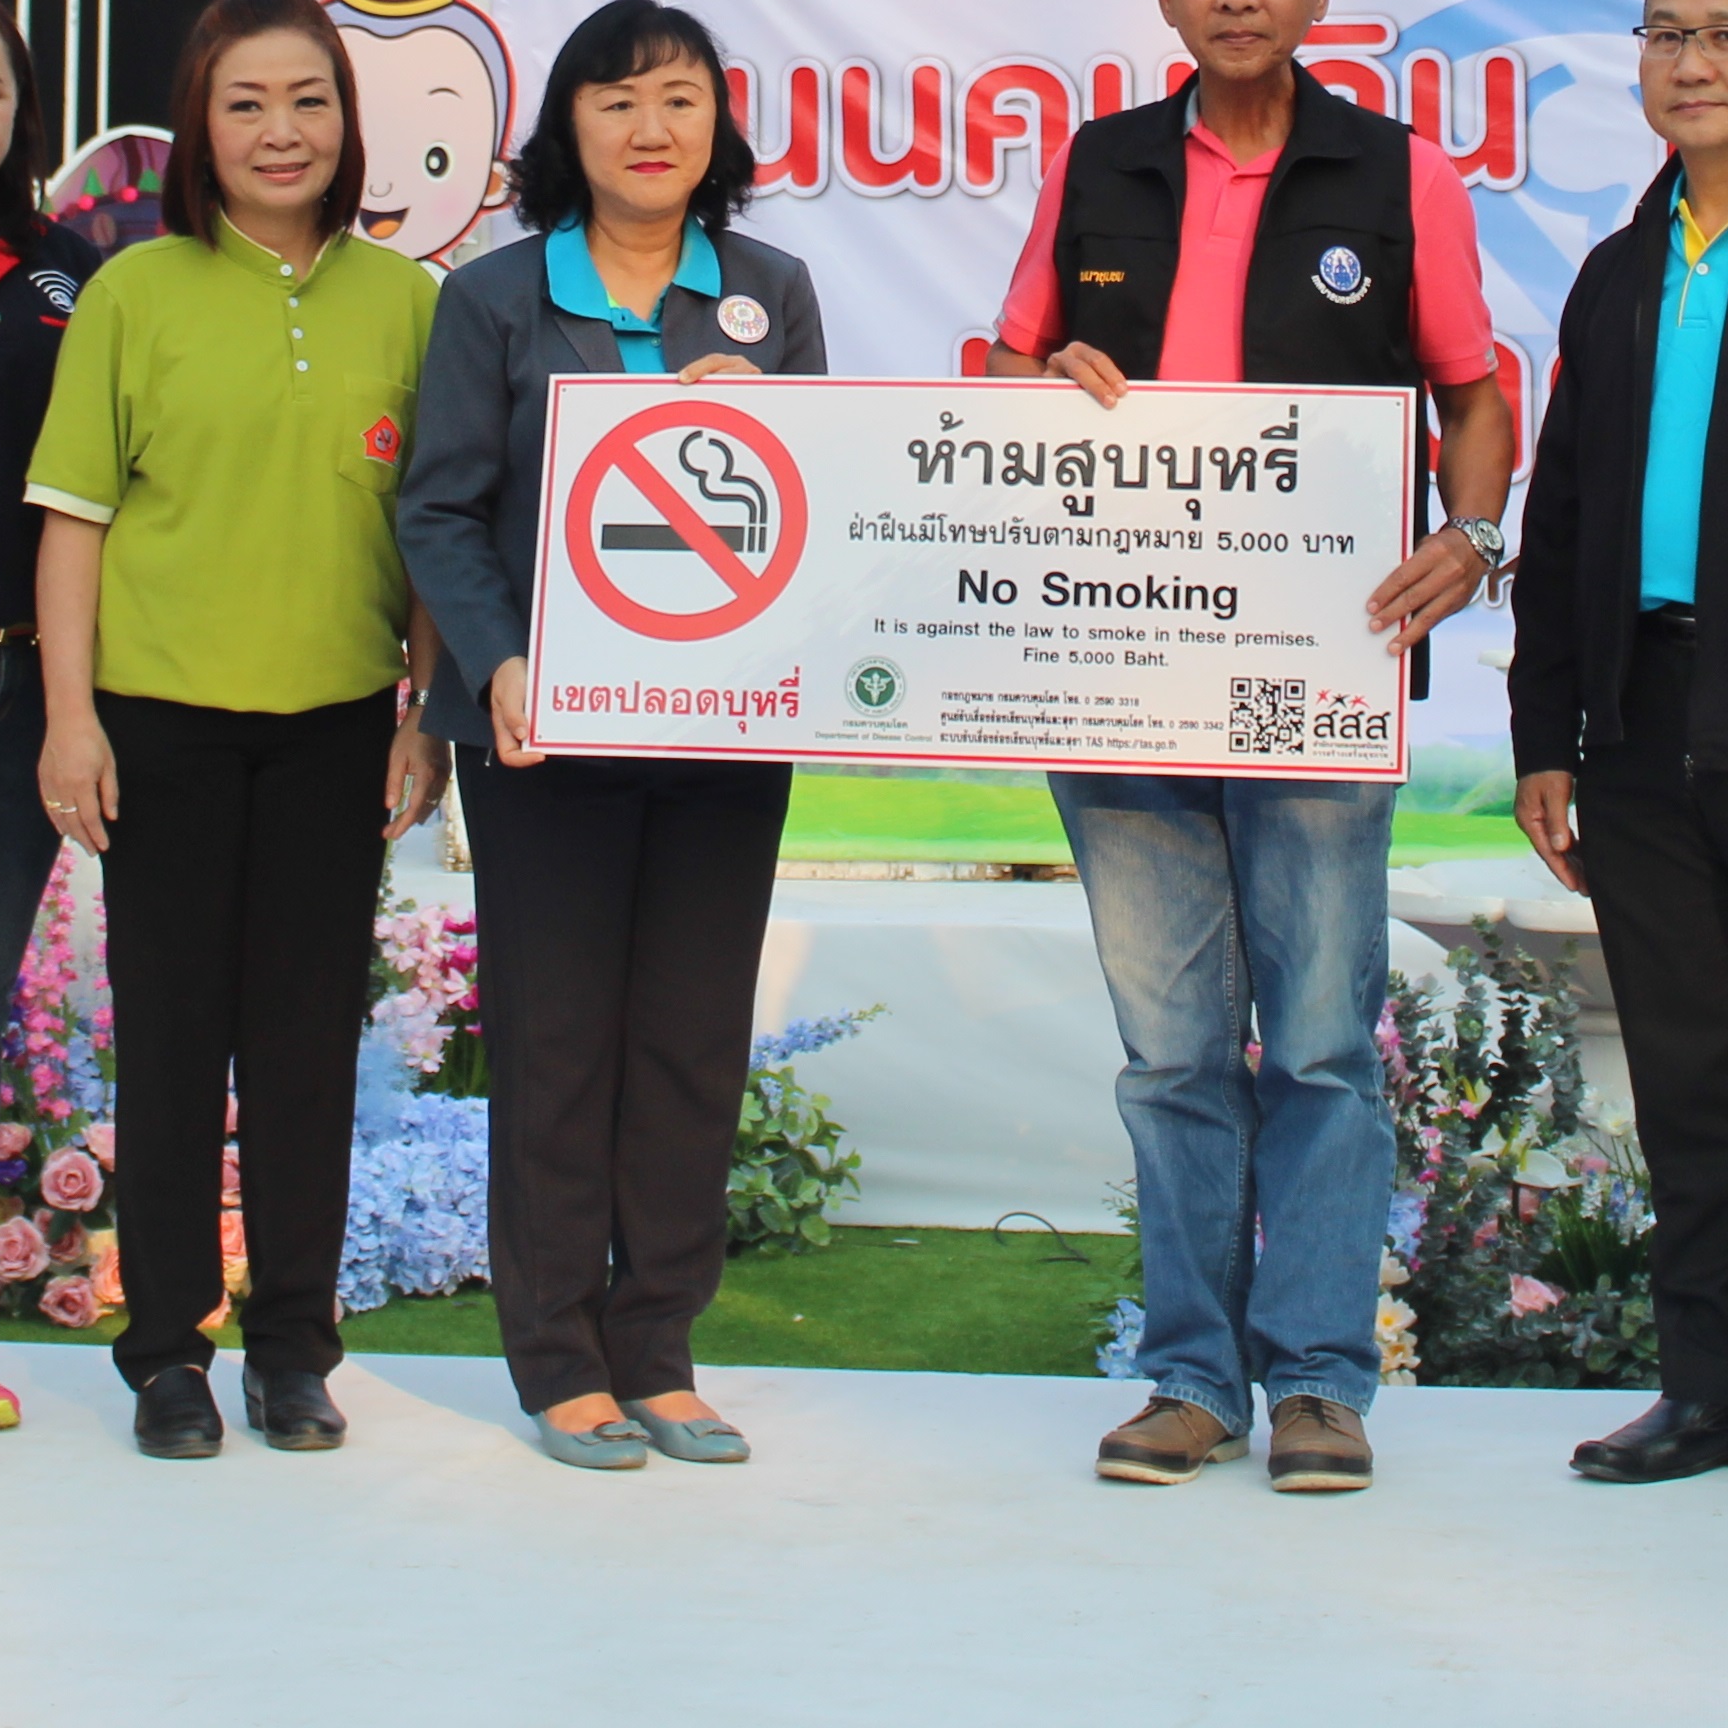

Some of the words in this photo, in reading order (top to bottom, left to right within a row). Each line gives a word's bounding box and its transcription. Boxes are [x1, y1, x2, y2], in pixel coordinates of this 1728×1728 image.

[906, 405, 1300, 522] ห้ามสูบบุหรี่
[848, 514, 1204, 556] ฝ่าฝืนมีโทษปรับตามกฎหมาย
[1301, 532, 1356, 556] บาท
[957, 569, 1019, 606] No
[1041, 571, 1239, 620] Smoking
[873, 617, 887, 634] It
[893, 618, 909, 635] is
[915, 619, 981, 641] against
[987, 621, 1017, 638] the
[1023, 622, 1055, 639] law
[1061, 624, 1080, 640] to
[1087, 625, 1147, 642] smoke
[1154, 627, 1170, 643] in
[1177, 628, 1227, 645] these
[1234, 630, 1320, 650] premises.
[1022, 646, 1061, 664] Fine
[1123, 649, 1170, 667] Baht.
[551, 667, 802, 735] เขตปลอดบุหรี่
[1085, 736, 1104, 747] TAS
[1313, 709, 1392, 740] สสส
